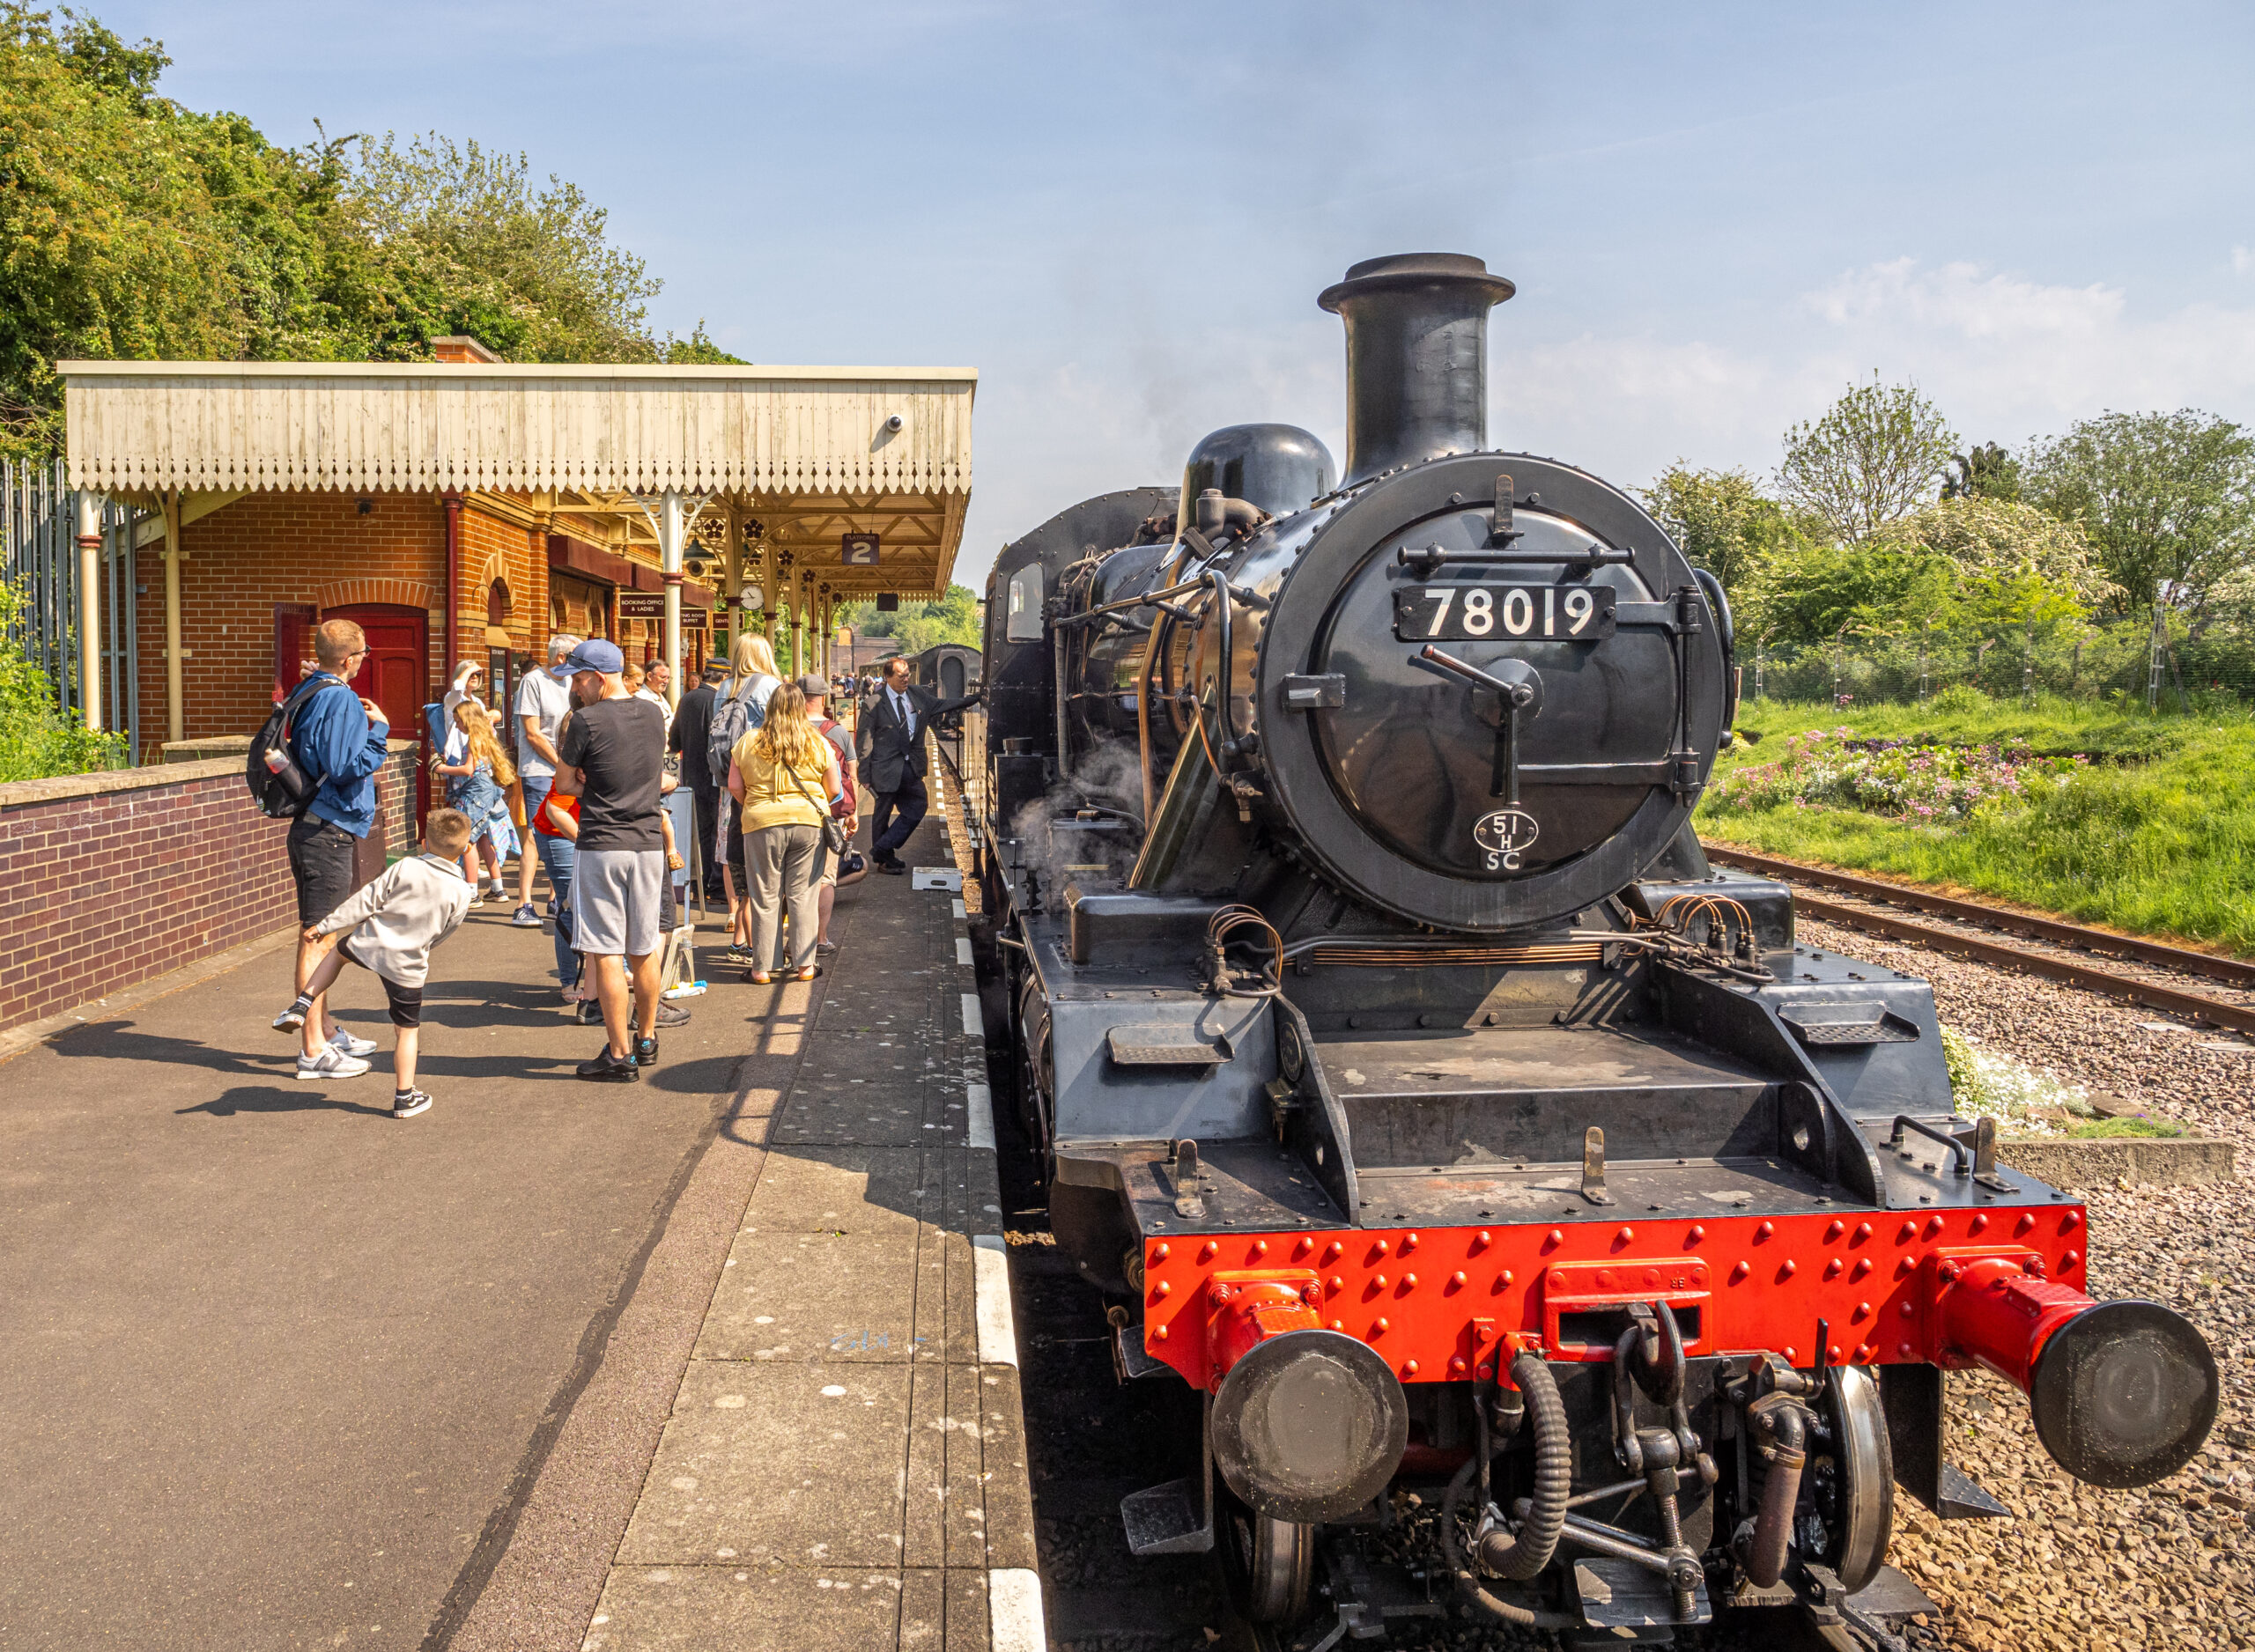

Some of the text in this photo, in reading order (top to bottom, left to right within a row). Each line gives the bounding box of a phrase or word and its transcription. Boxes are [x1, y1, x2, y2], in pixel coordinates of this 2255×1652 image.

[851, 542, 871, 563] 2
[1424, 588, 1593, 636] 78019
[1493, 815, 1518, 835] 51
[1500, 834, 1512, 849] H
[1487, 852, 1520, 871] SC
